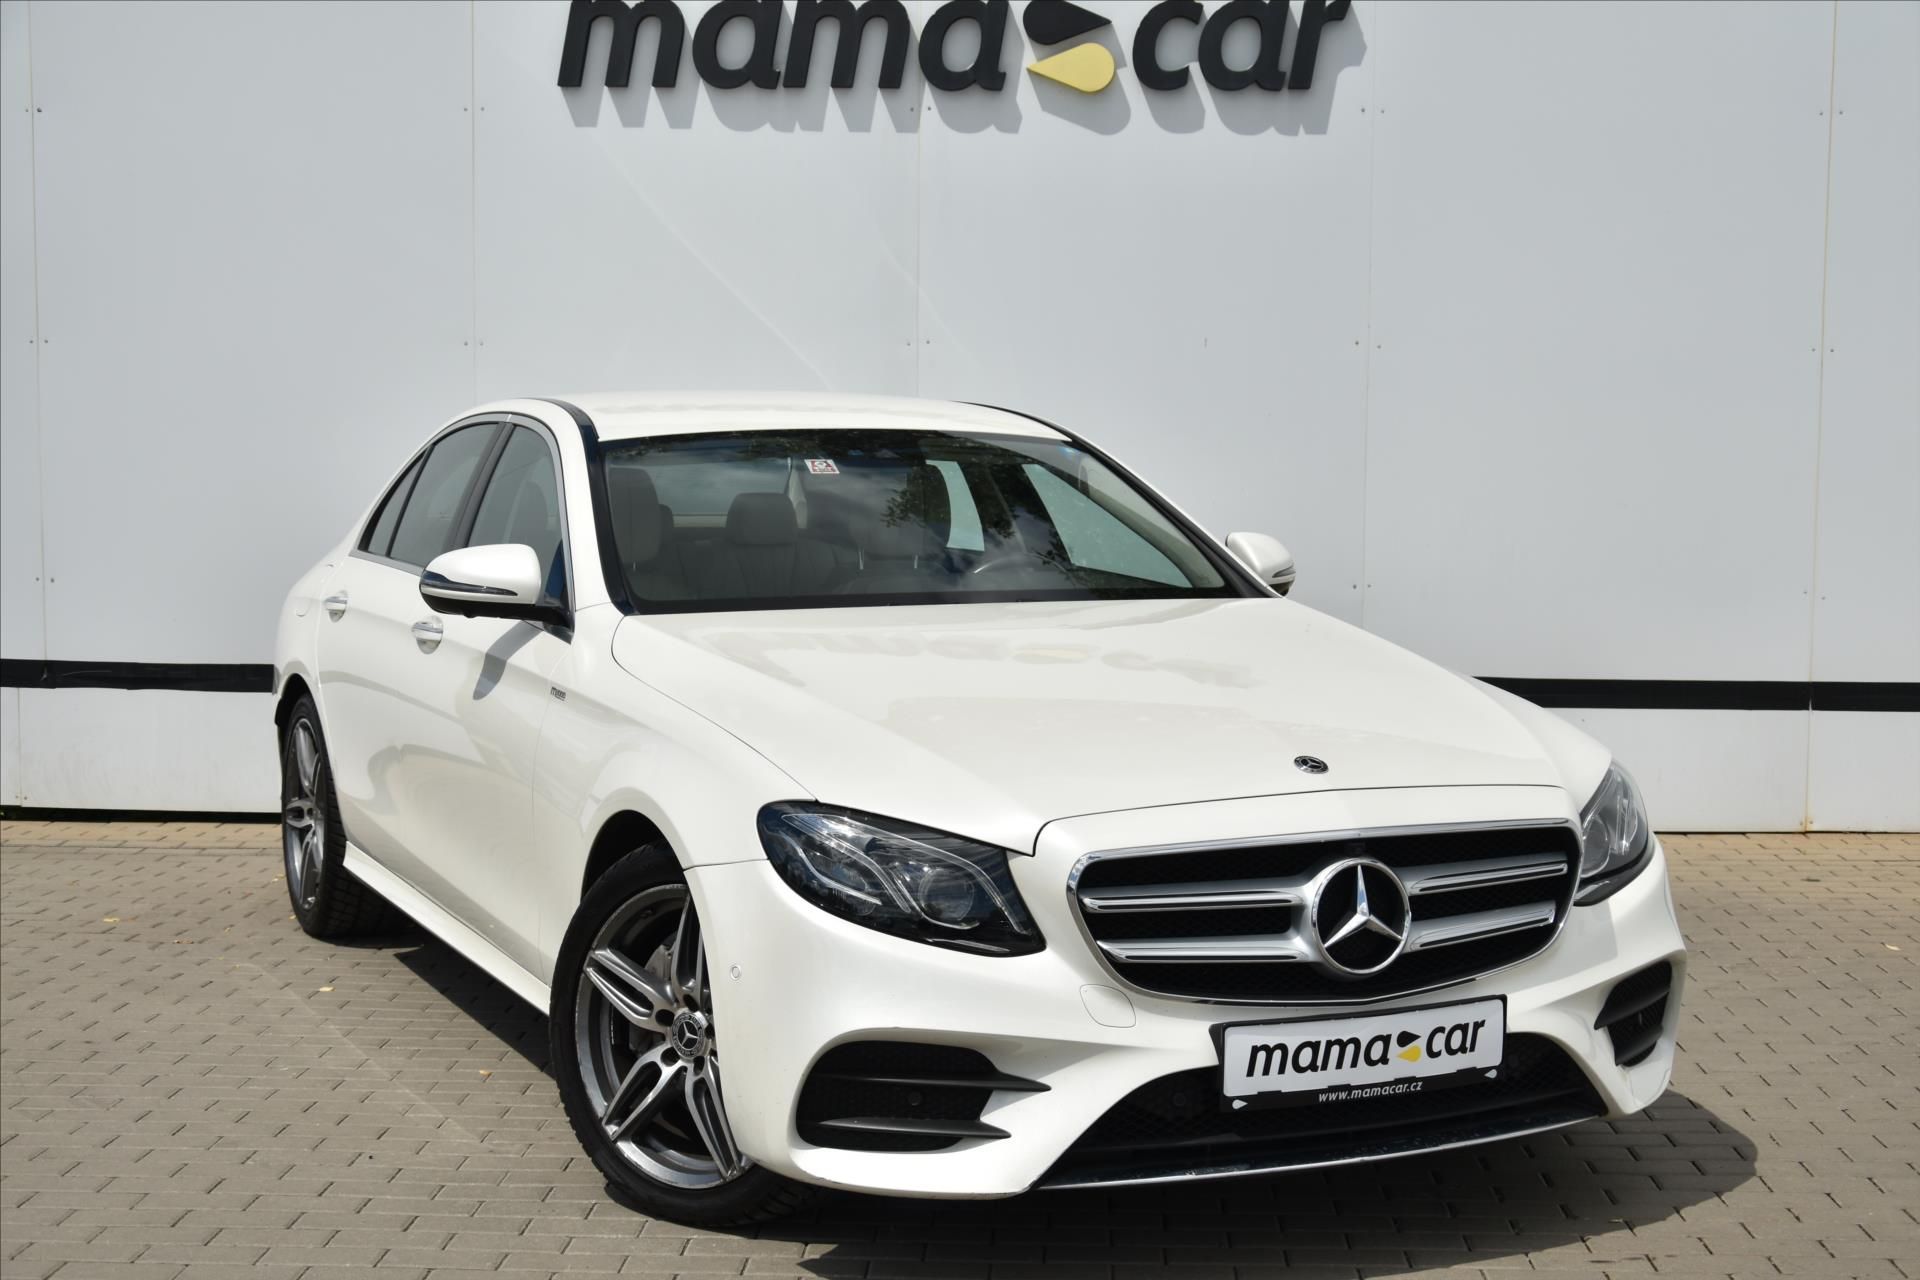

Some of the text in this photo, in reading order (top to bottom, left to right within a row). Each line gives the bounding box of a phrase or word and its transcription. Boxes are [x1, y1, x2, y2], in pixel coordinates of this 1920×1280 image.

[557, 0, 1350, 91] mama car
[1246, 1019, 1486, 1077] mama car
[1319, 1081, 1423, 1103] www.mamacar.cz
